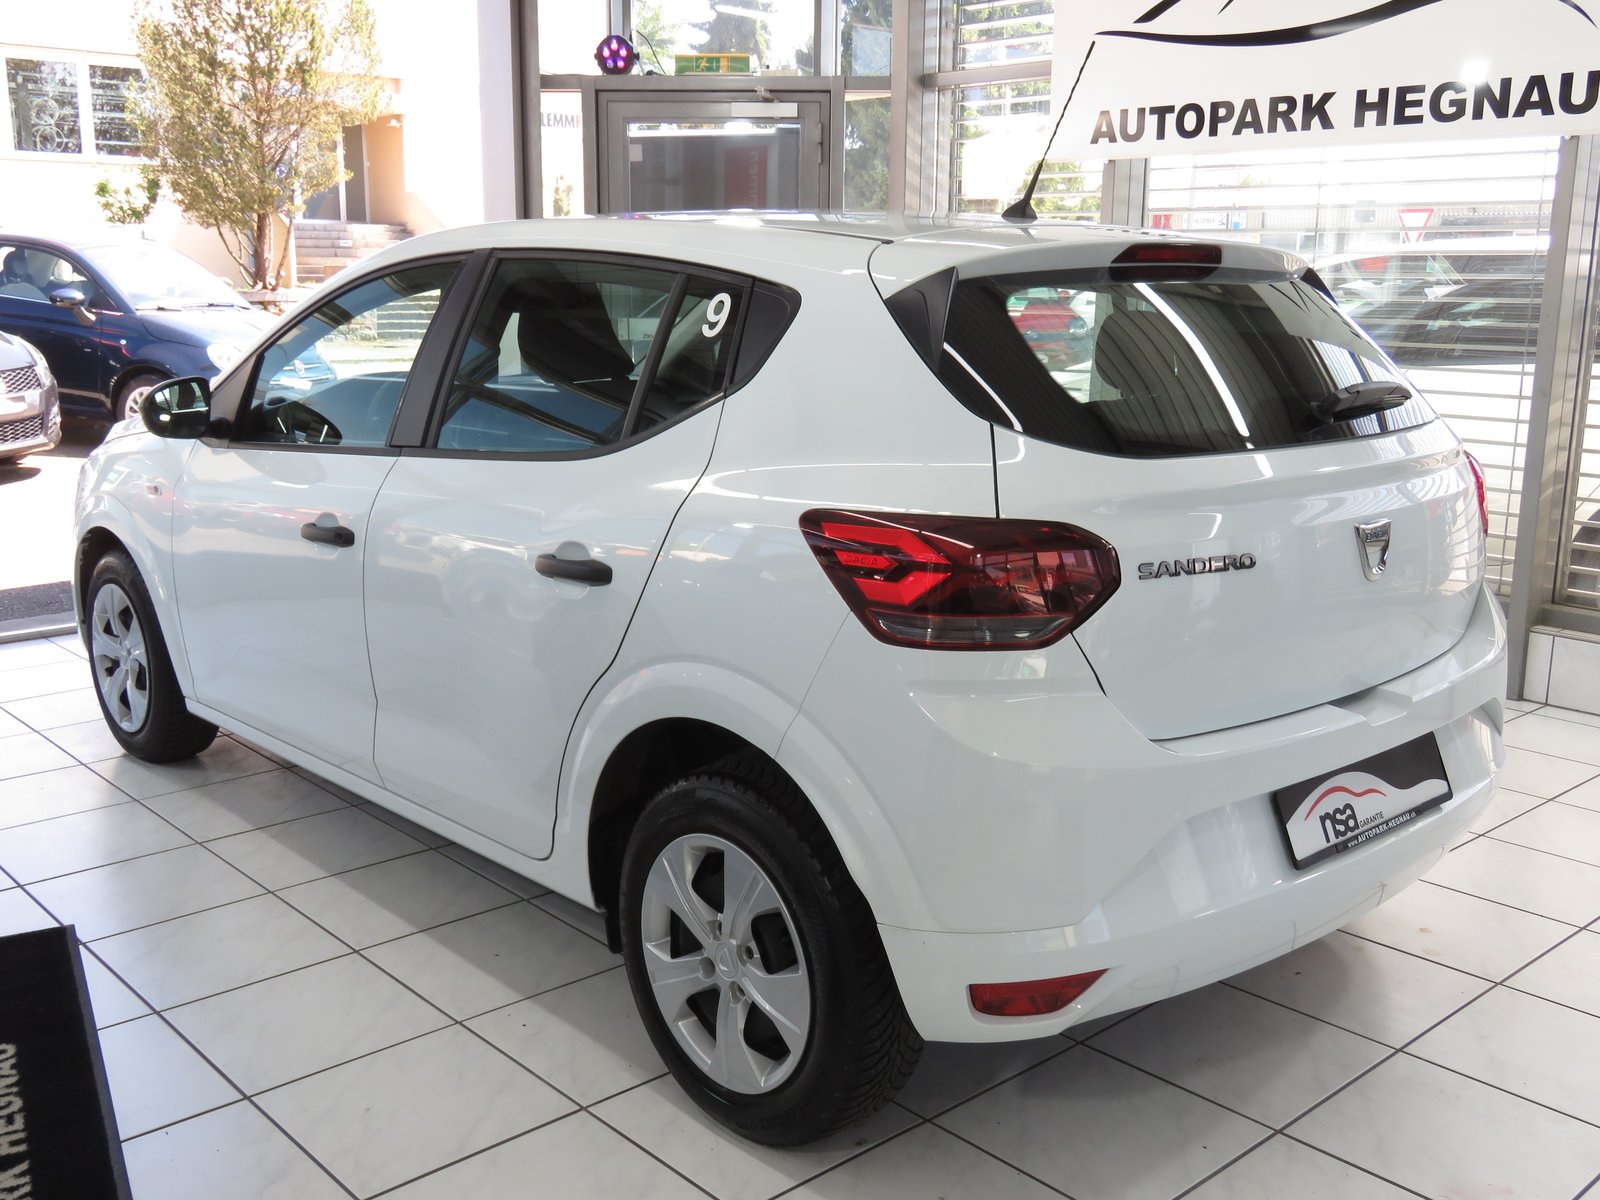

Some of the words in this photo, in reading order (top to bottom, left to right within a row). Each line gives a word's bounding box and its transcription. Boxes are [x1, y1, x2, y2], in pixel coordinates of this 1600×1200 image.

[1090, 91, 1337, 145] AUTOPARK
[1353, 70, 1600, 128] HEGNAU
[701, 292, 731, 337] 9
[845, 555, 878, 566] DACIA
[1138, 553, 1257, 580] SANDERO
[1319, 803, 1359, 843] nsa
[1359, 811, 1384, 828] GARANTIE
